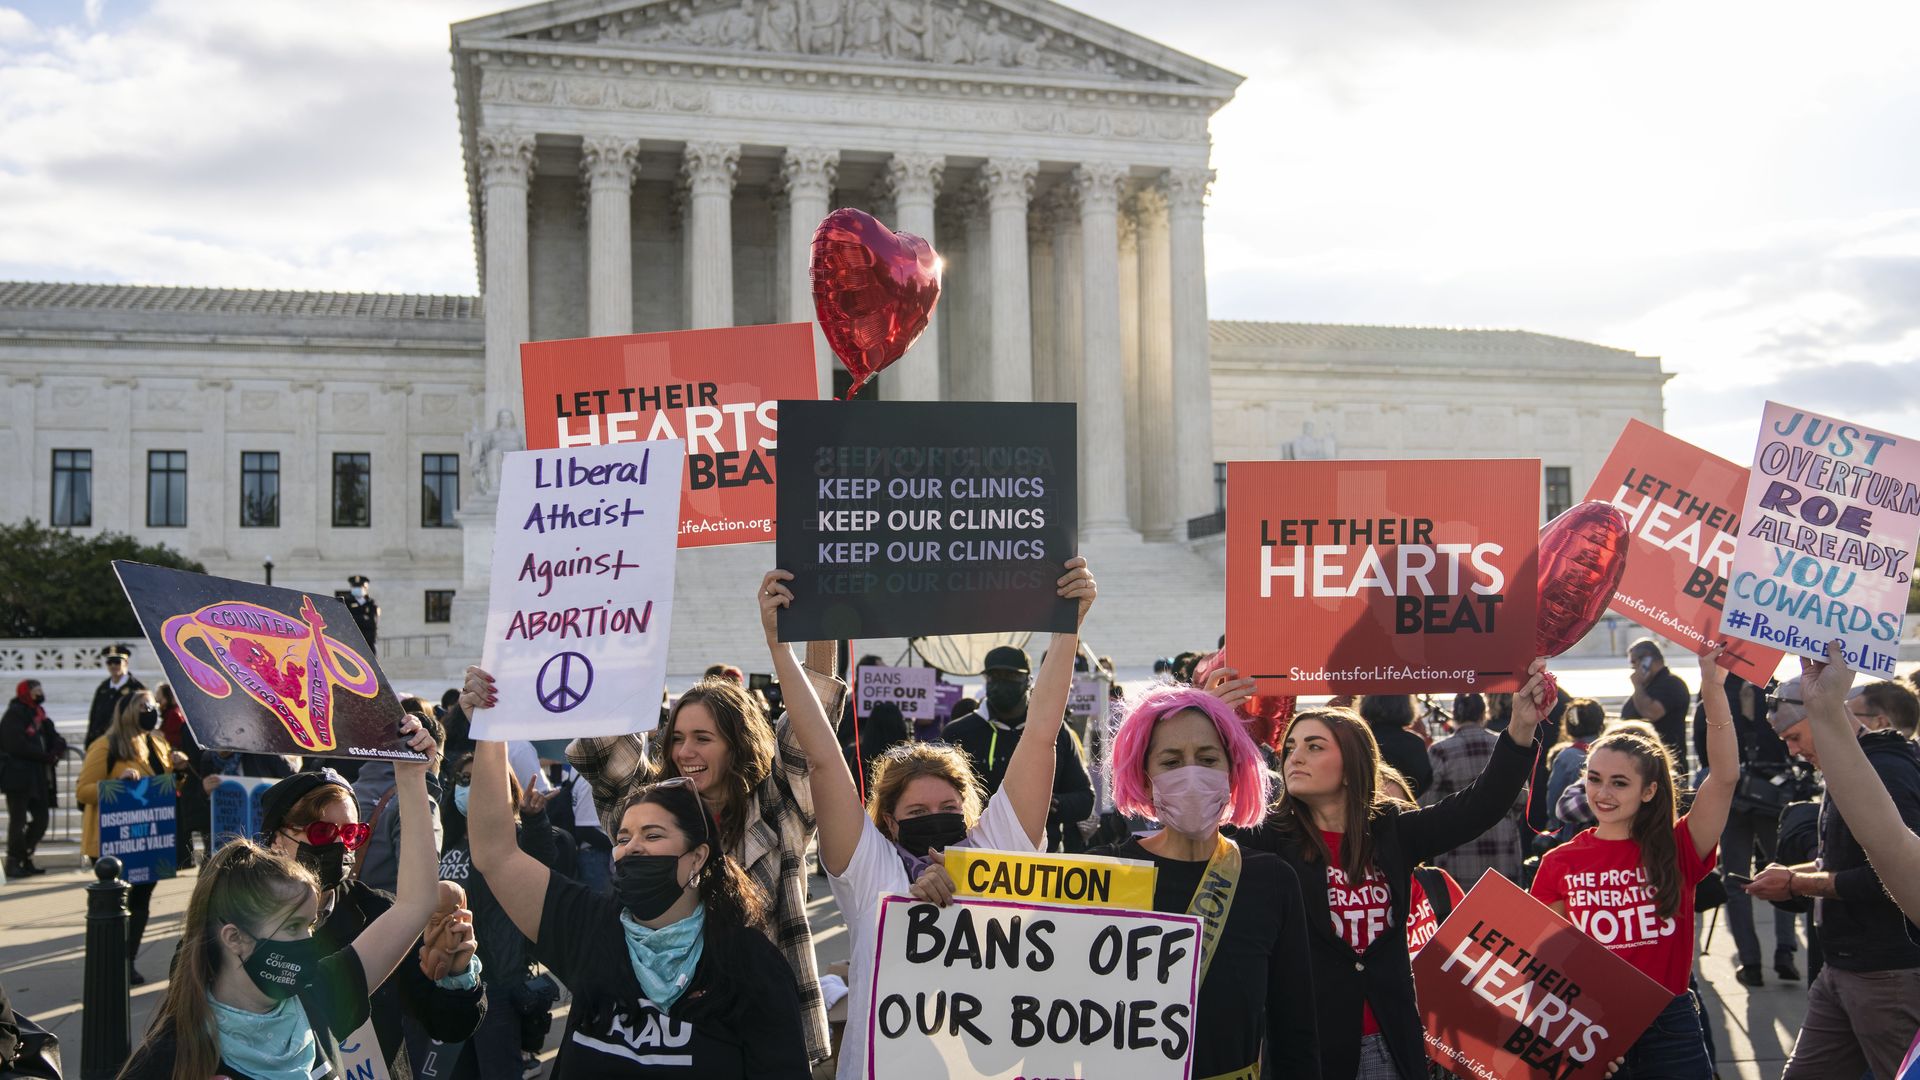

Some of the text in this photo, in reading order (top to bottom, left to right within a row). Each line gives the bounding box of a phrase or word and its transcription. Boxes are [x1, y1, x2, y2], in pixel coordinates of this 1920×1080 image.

[556, 382, 719, 418] LET THEIR
[1774, 412, 1897, 465] JUST
[689, 449, 778, 490] BEA
[818, 477, 1044, 499] KEEP OUR CLINICS
[1759, 441, 1920, 516] OVERTURN
[523, 498, 644, 533] Atheist
[818, 510, 880, 531] KEEP
[887, 509, 942, 530] OUR
[949, 508, 1045, 530] CLINICS
[1622, 467, 1741, 537] LET THEI
[1759, 480, 1873, 538] ROE
[677, 517, 771, 534] ifeAction.org
[1260, 518, 1433, 546] LET THEIR
[1611, 485, 1738, 579] HEAR
[818, 539, 1045, 563] KEEP OUR CLINICS
[1748, 515, 1909, 584] ALREADY,
[518, 546, 640, 597] Against
[1260, 542, 1505, 598] HEARTS
[1682, 566, 1729, 612] BE
[1773, 546, 1857, 598] YOU
[210, 610, 297, 637] COUNTER
[1395, 594, 1503, 634] BEAT
[1613, 590, 1723, 656] entsforLifeAction.or
[1734, 571, 1905, 645] COWARDS!
[863, 672, 902, 685] BANS
[863, 686, 891, 698] OFF
[893, 687, 927, 699] OUR
[1290, 666, 1475, 684] StudentsforLifeAction.org
[101, 806, 175, 828] DISCRIMINATION
[120, 822, 158, 840] IS NOT A
[102, 833, 175, 856] CATHOLIC VALUE
[967, 859, 1112, 902] CAUTION
[1564, 866, 1650, 890] THE PRO-LI
[1568, 885, 1659, 907] GENERATIO
[270, 952, 285, 961] GET
[906, 904, 1195, 984] BANS OFF
[1467, 920, 1582, 1006] LET THEIR
[260, 970, 296, 986] COVERED
[266, 958, 302, 972] COVERED
[281, 970, 297, 979] STAY
[1440, 936, 1609, 1062] HEARTS
[879, 990, 1189, 1060] OUR BODIES
[1503, 1023, 1585, 1080] BEAT
